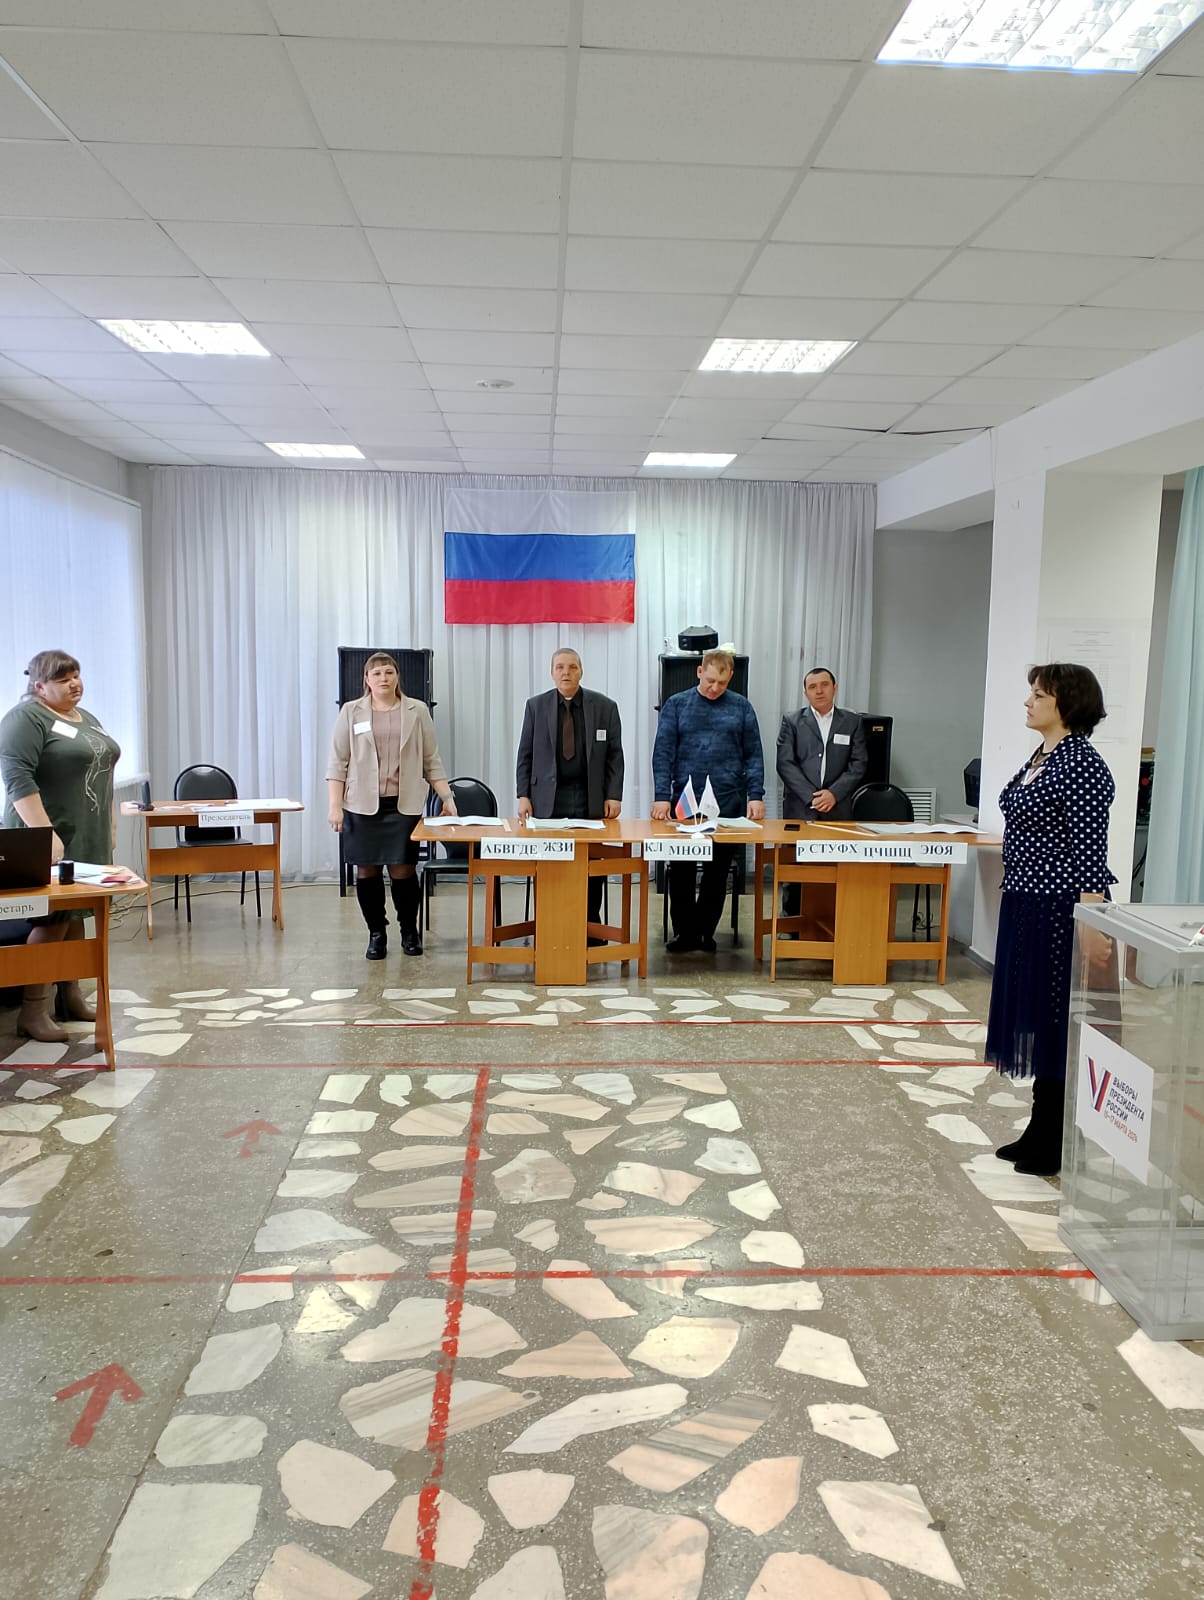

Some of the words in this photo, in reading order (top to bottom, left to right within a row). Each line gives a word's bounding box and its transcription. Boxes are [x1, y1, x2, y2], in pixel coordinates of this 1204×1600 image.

[483, 843, 538, 856] АБВГДЕ
[543, 841, 573, 853] ЖЗИ
[645, 842, 663, 852] КЛ
[669, 845, 712, 856] МНОП
[809, 843, 859, 854] СТУФХ
[864, 847, 912, 859] ЦЧШЩ
[920, 844, 953, 855] ЭЮЯ
[1112, 1076, 1138, 1101] ВЫБОРЫ
[1106, 1099, 1129, 1122] РОССИИ
[1109, 1087, 1145, 1122] ПРЕЗИДЕНТА
